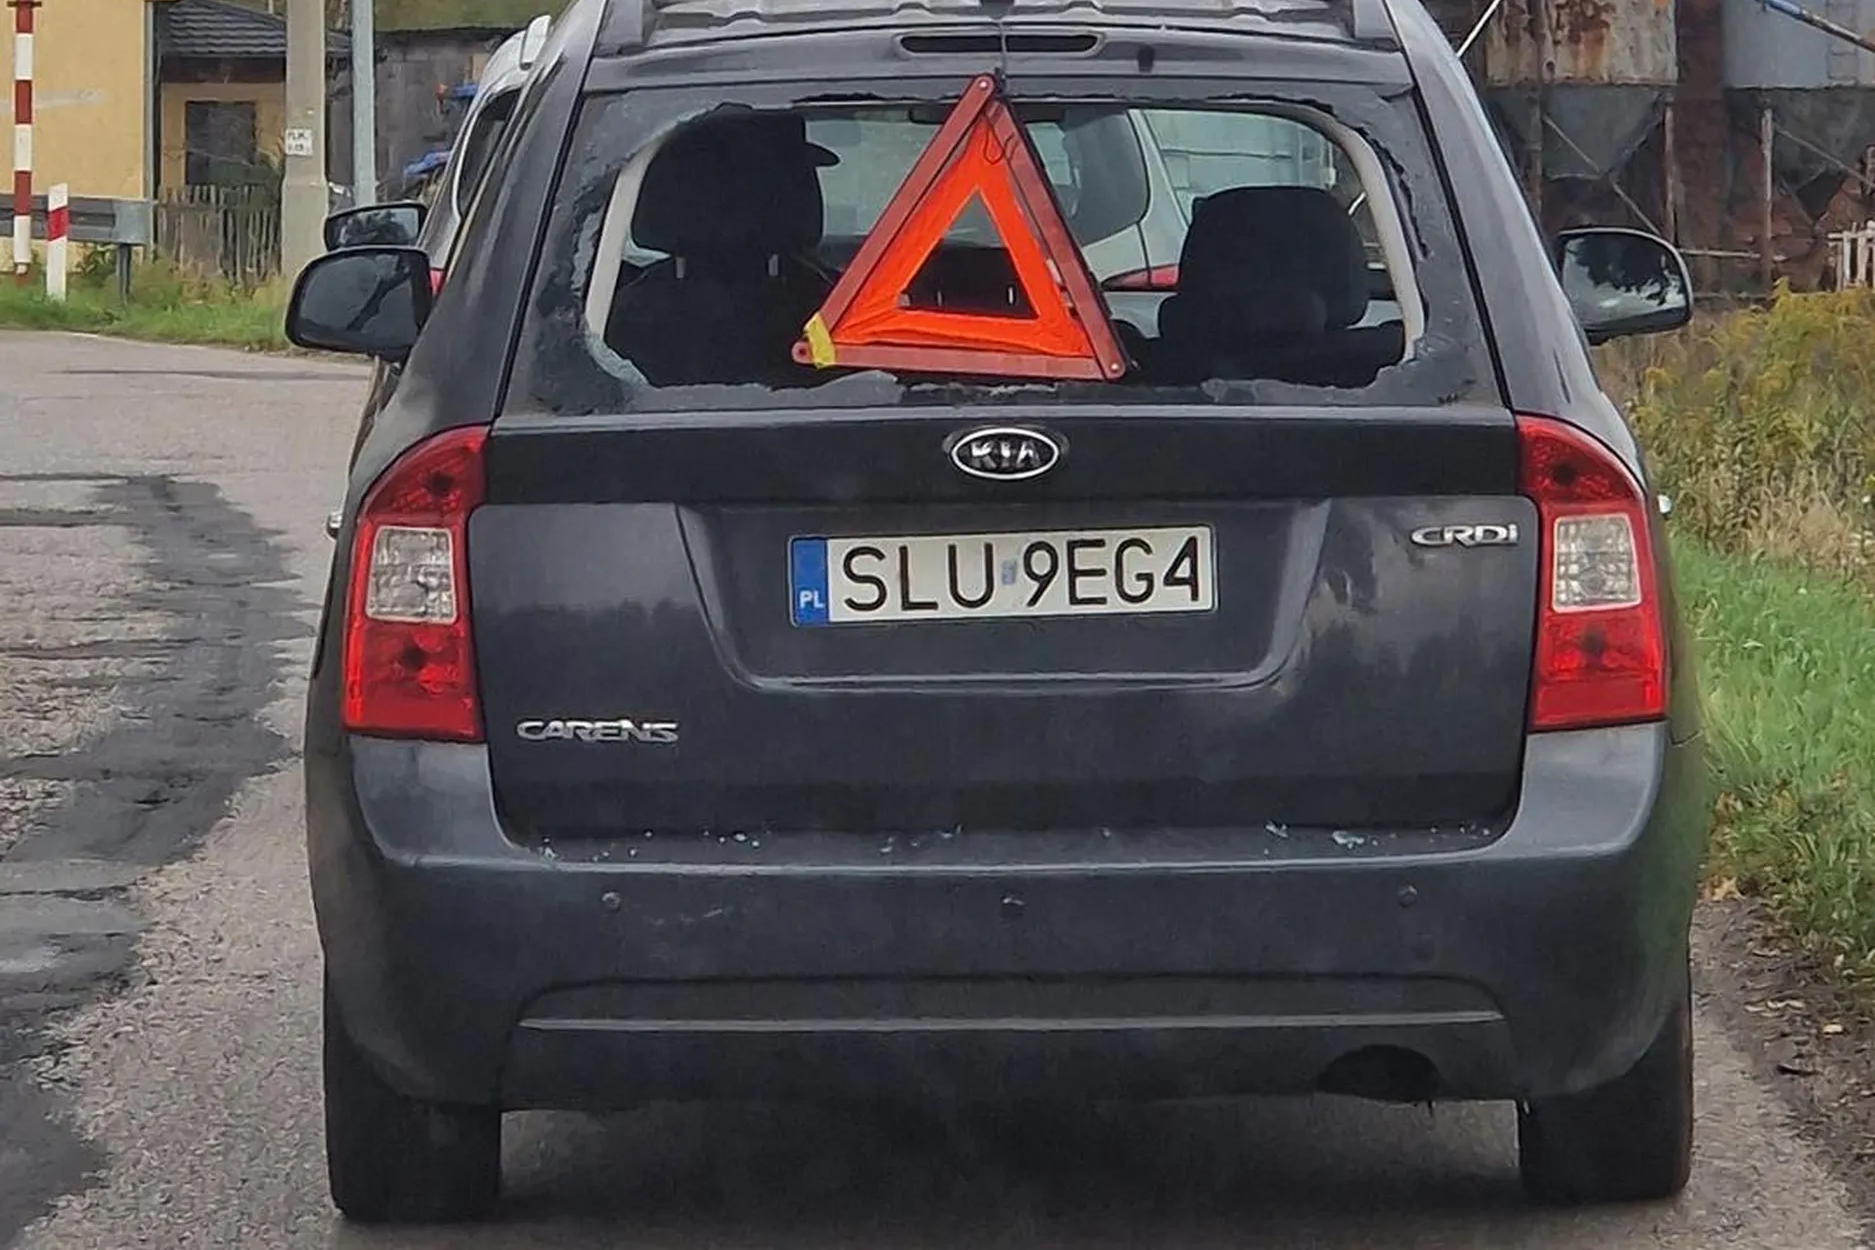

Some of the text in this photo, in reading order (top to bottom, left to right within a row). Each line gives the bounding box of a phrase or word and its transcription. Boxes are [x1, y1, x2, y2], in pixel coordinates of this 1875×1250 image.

[970, 441, 1040, 468] KIA
[842, 535, 1200, 612] SLU 9EG4
[800, 591, 825, 609] PL
[517, 719, 679, 742] CARENS
